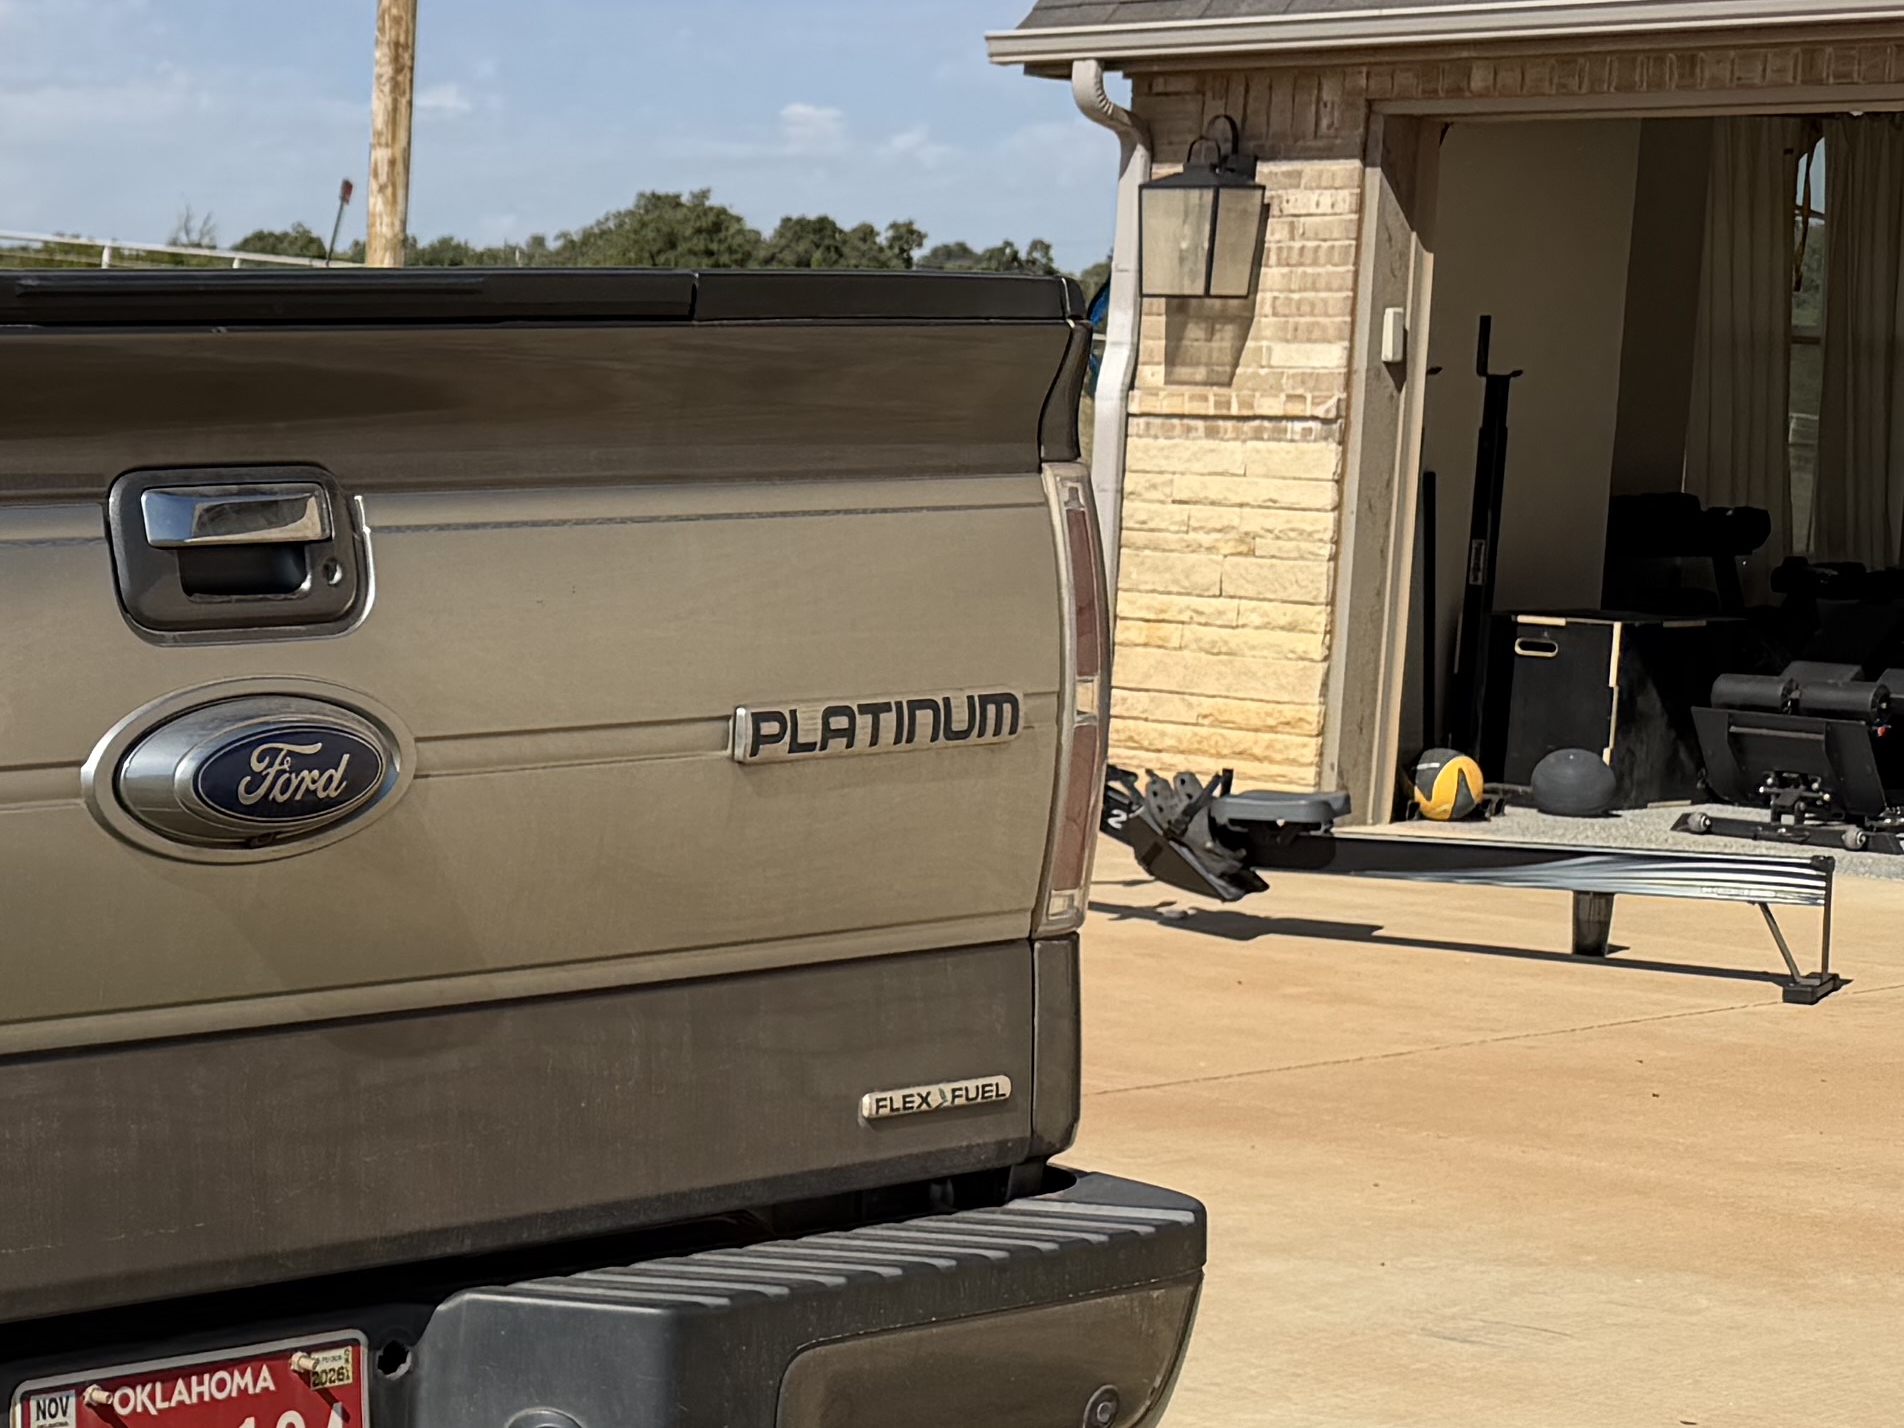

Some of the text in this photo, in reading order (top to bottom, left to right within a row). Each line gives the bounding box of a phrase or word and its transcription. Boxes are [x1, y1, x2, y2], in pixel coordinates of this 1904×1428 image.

[749, 691, 1020, 758] PLATINUM
[237, 742, 350, 805] Ford
[874, 1082, 1007, 1116] FLEX FUEL
[113, 1364, 276, 1416] OKLAHOMA
[311, 1365, 345, 1388] 2026
[36, 1395, 70, 1421] NOV
